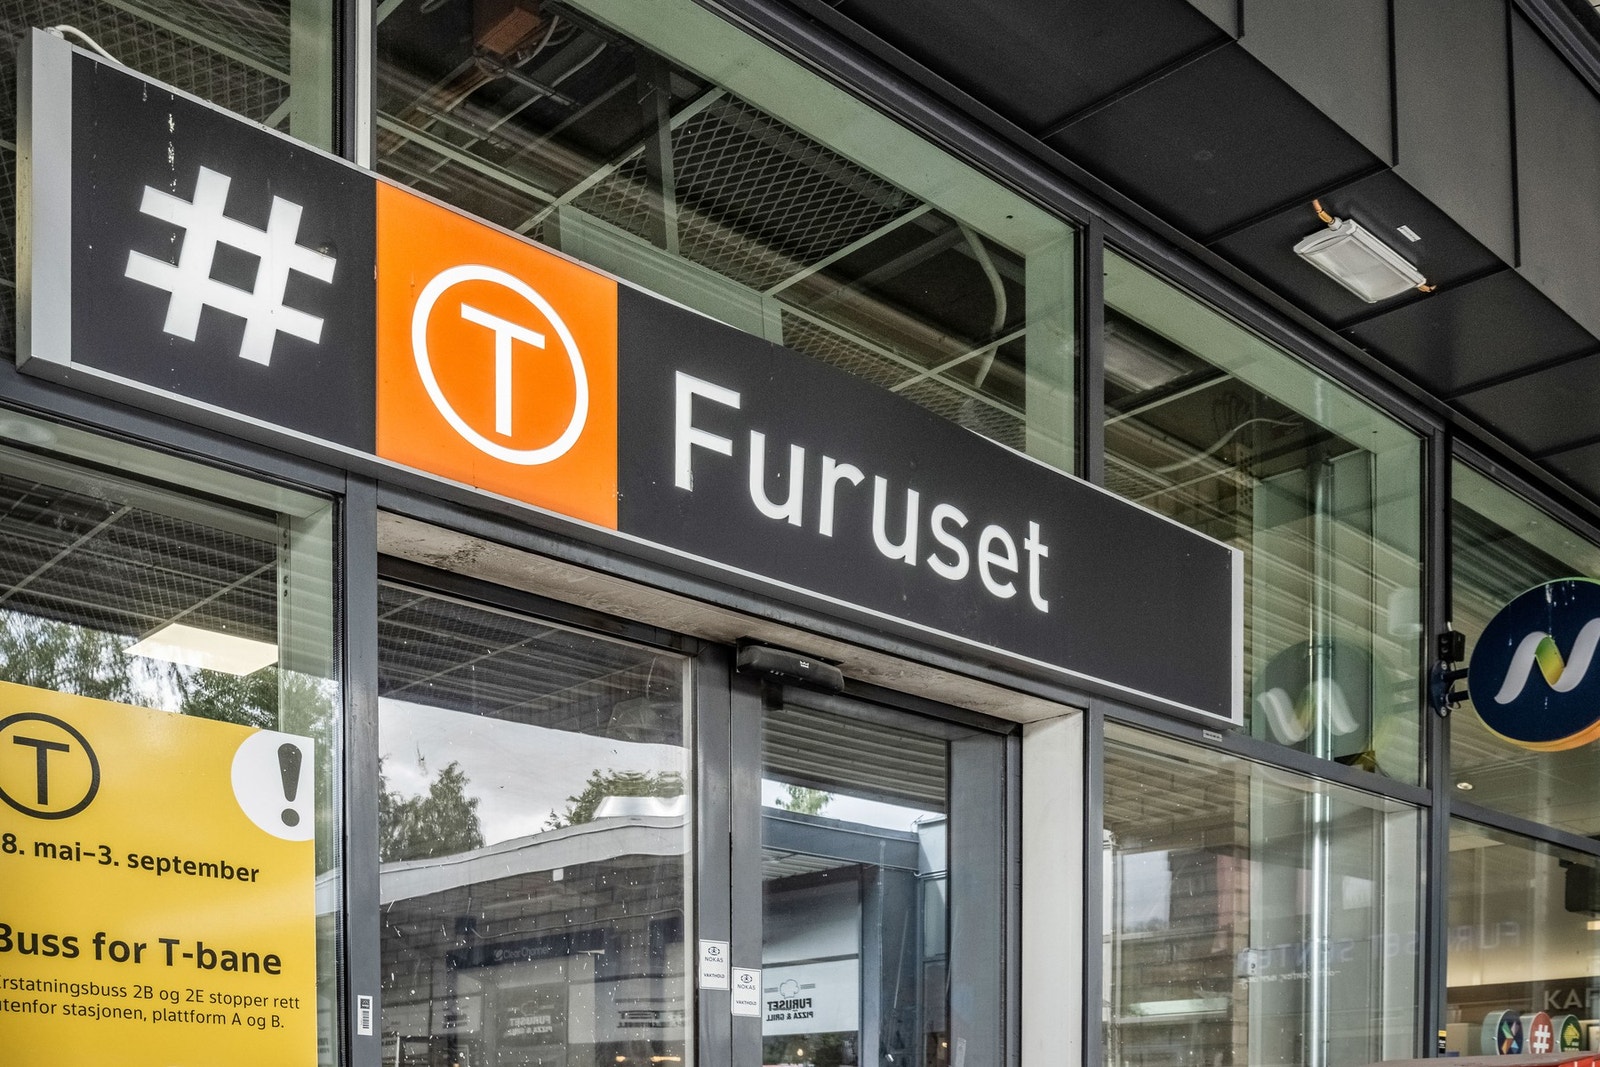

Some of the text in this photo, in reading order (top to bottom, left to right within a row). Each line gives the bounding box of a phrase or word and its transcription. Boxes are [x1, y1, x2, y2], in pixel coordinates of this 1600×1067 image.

[674, 370, 1050, 613] Furuset
[2, 833, 25, 855] 8.
[127, 852, 260, 883] september
[0, 922, 282, 975] Buss for T-bane
[0, 975, 300, 1010] rstatningsbuss 2B og 2E stopper rett
[62, 1003, 147, 1022] stasjonen,
[152, 1008, 226, 1025] plattform
[231, 1012, 242, 1026] A
[247, 1016, 266, 1030] og
[271, 1014, 285, 1029] B.
